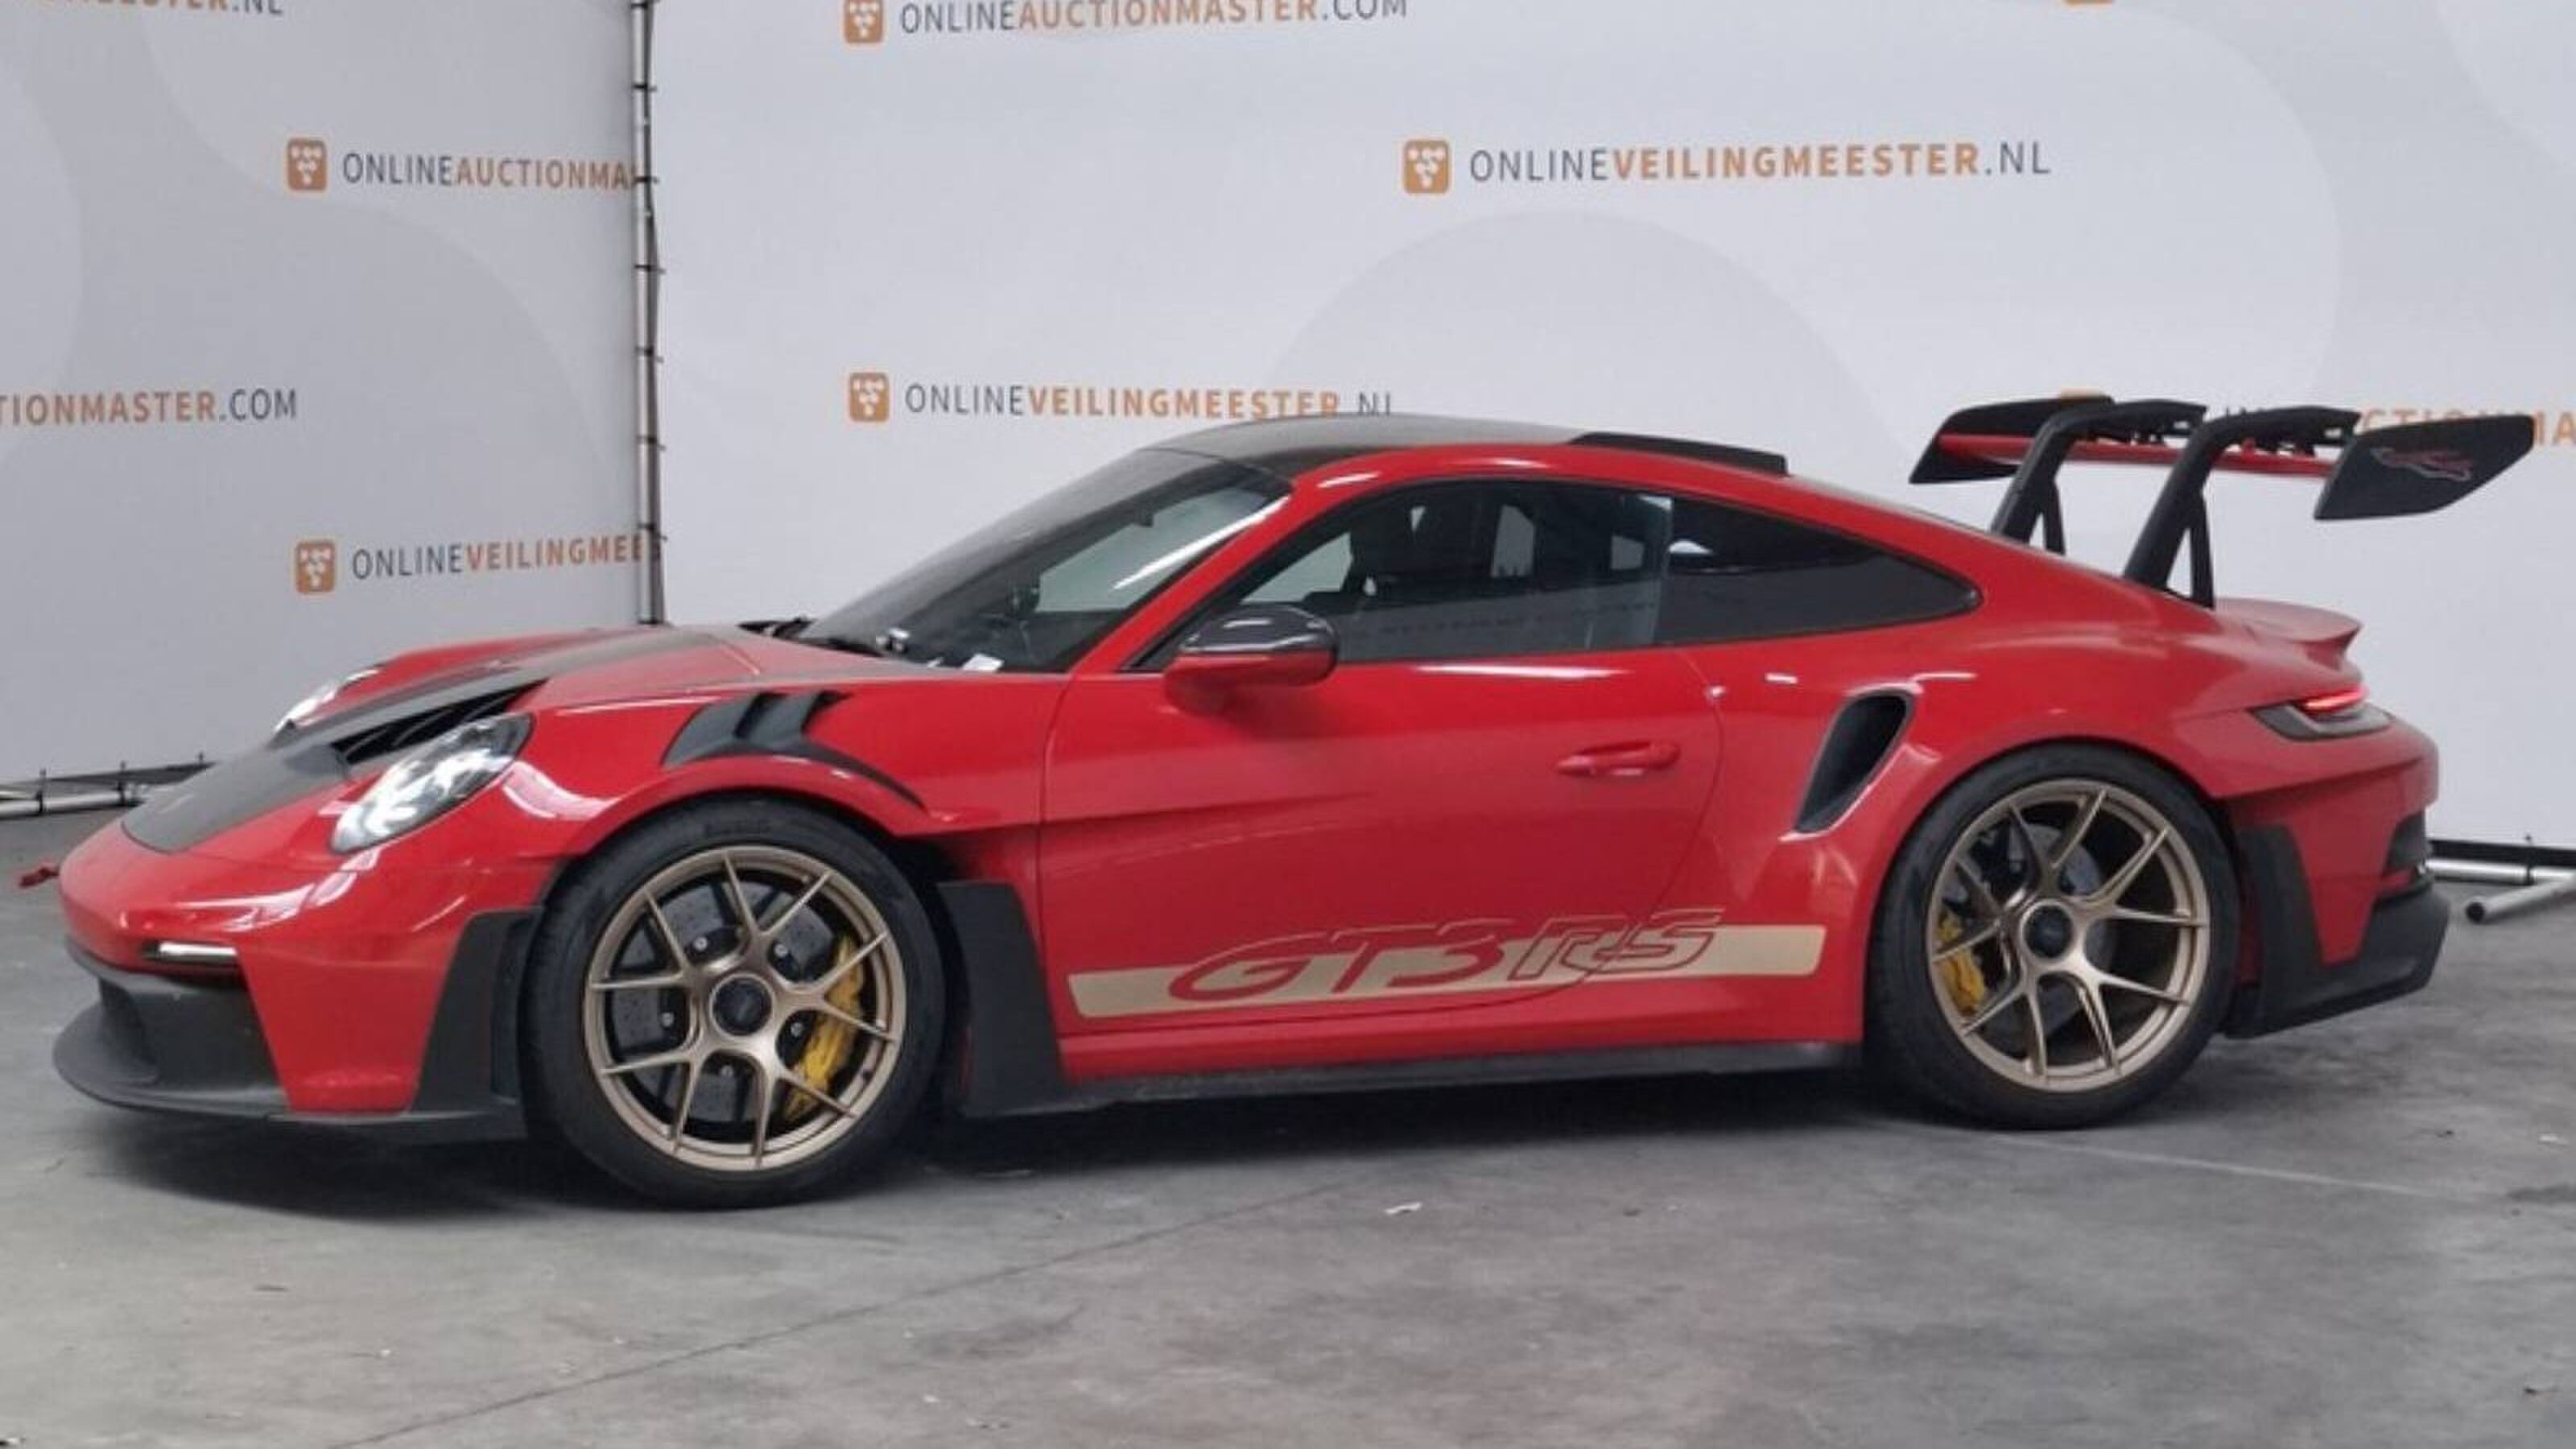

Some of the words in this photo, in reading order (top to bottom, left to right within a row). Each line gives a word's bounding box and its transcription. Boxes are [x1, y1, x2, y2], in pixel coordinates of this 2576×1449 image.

[1469, 140, 2051, 182] ONLINEVEILINGMEESTER.NL
[904, 382, 1391, 420] ONLINEVEILINGMEESTERNL
[352, 532, 660, 580] ONLINEVEILINGMEE
